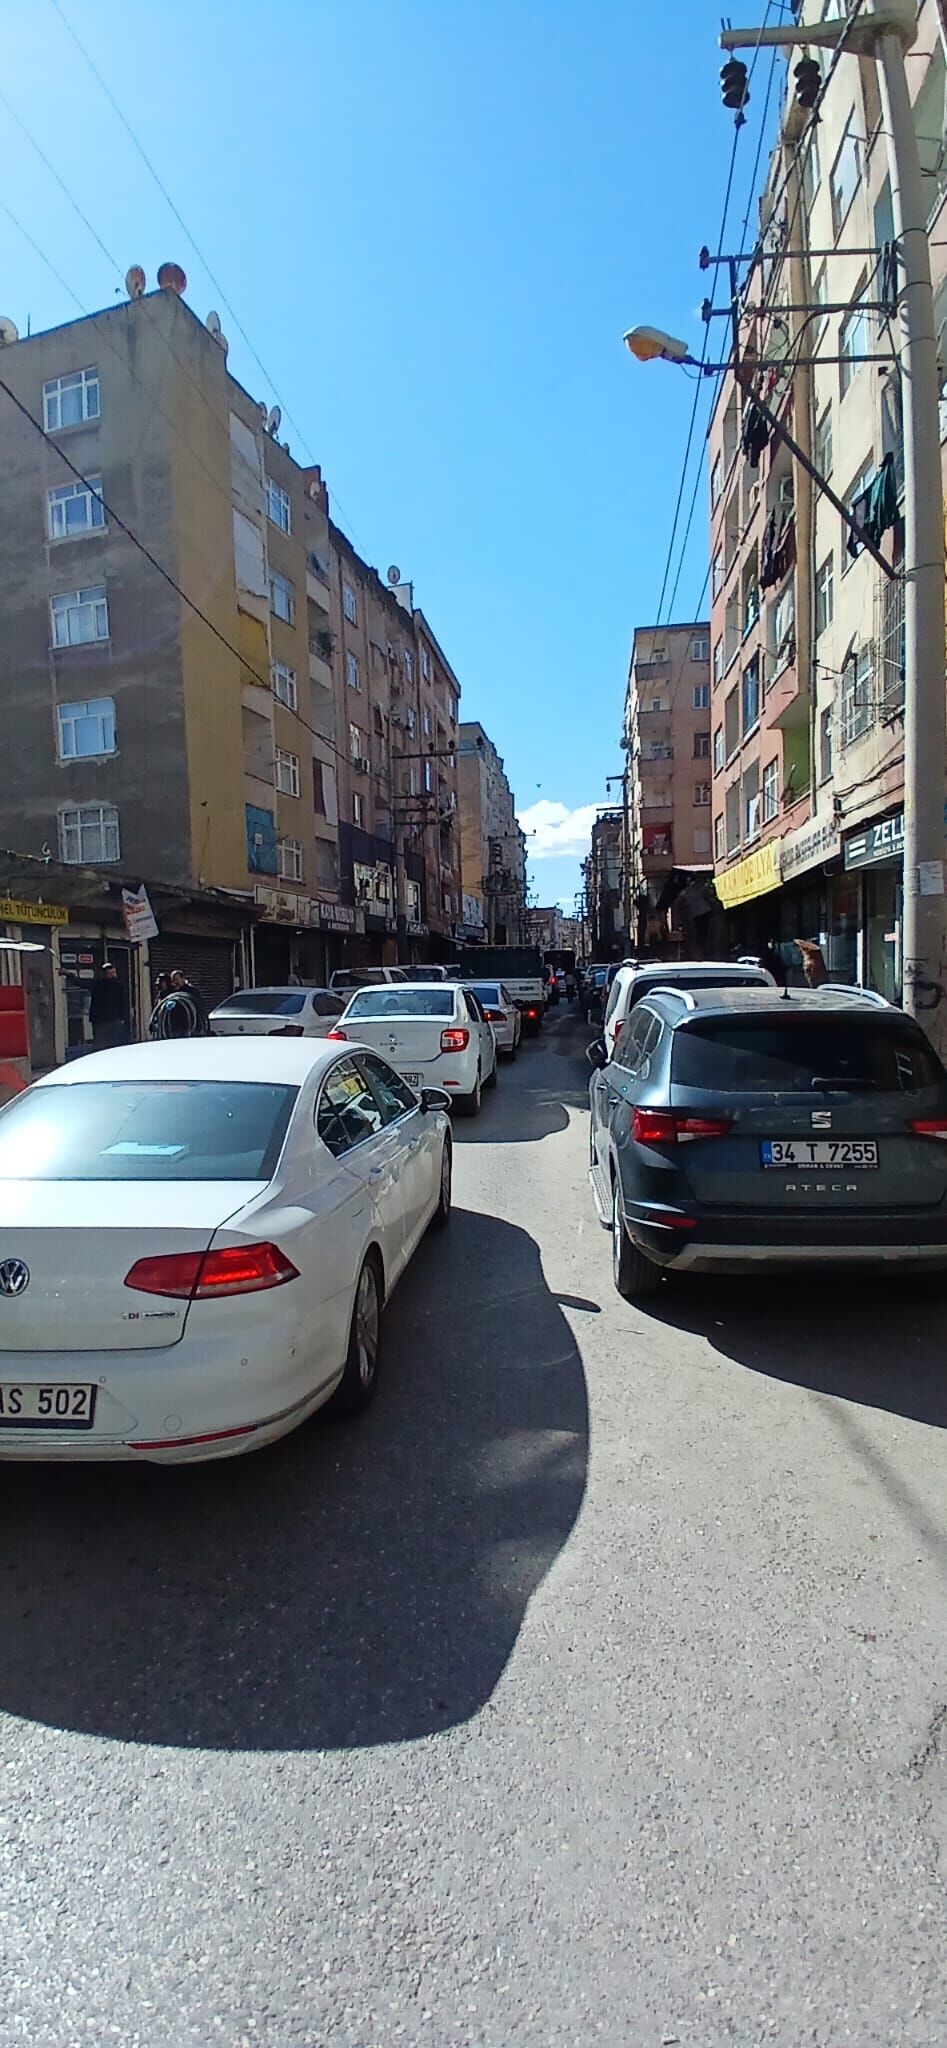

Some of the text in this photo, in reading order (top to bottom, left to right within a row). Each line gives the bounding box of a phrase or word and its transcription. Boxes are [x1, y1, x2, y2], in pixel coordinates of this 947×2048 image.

[772, 1143, 875, 1162] 34 T 7255
[38, 1389, 87, 1415] 502
